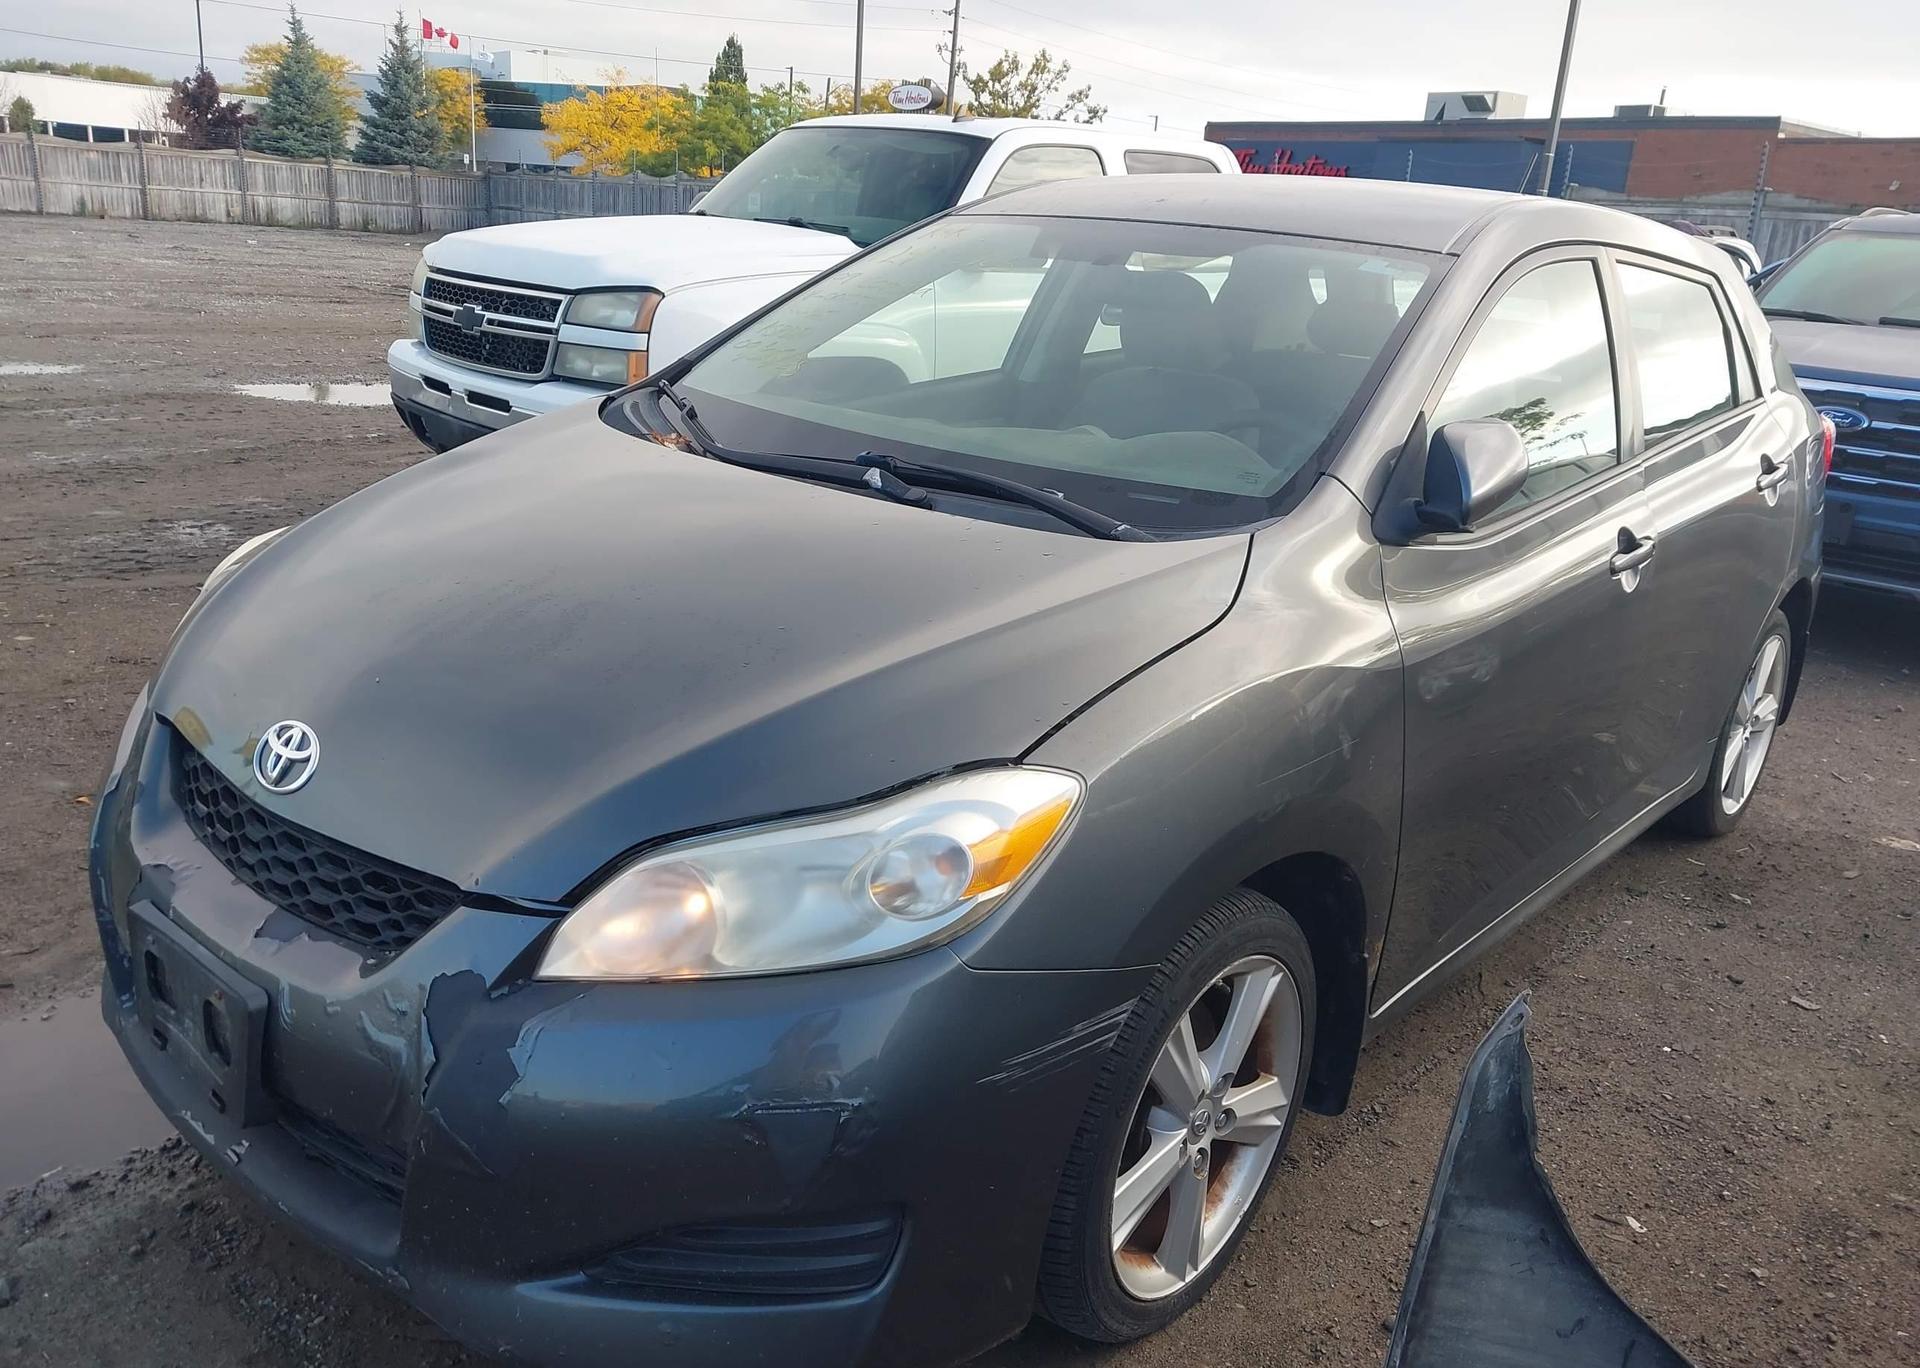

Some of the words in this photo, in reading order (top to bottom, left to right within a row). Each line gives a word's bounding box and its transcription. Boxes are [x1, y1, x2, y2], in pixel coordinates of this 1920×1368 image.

[892, 90, 904, 104] Tim
[905, 90, 928, 104] Hortons
[1234, 148, 1265, 174] Tim
[1269, 148, 1347, 176] Hortons
[1820, 410, 1853, 425] Ford
